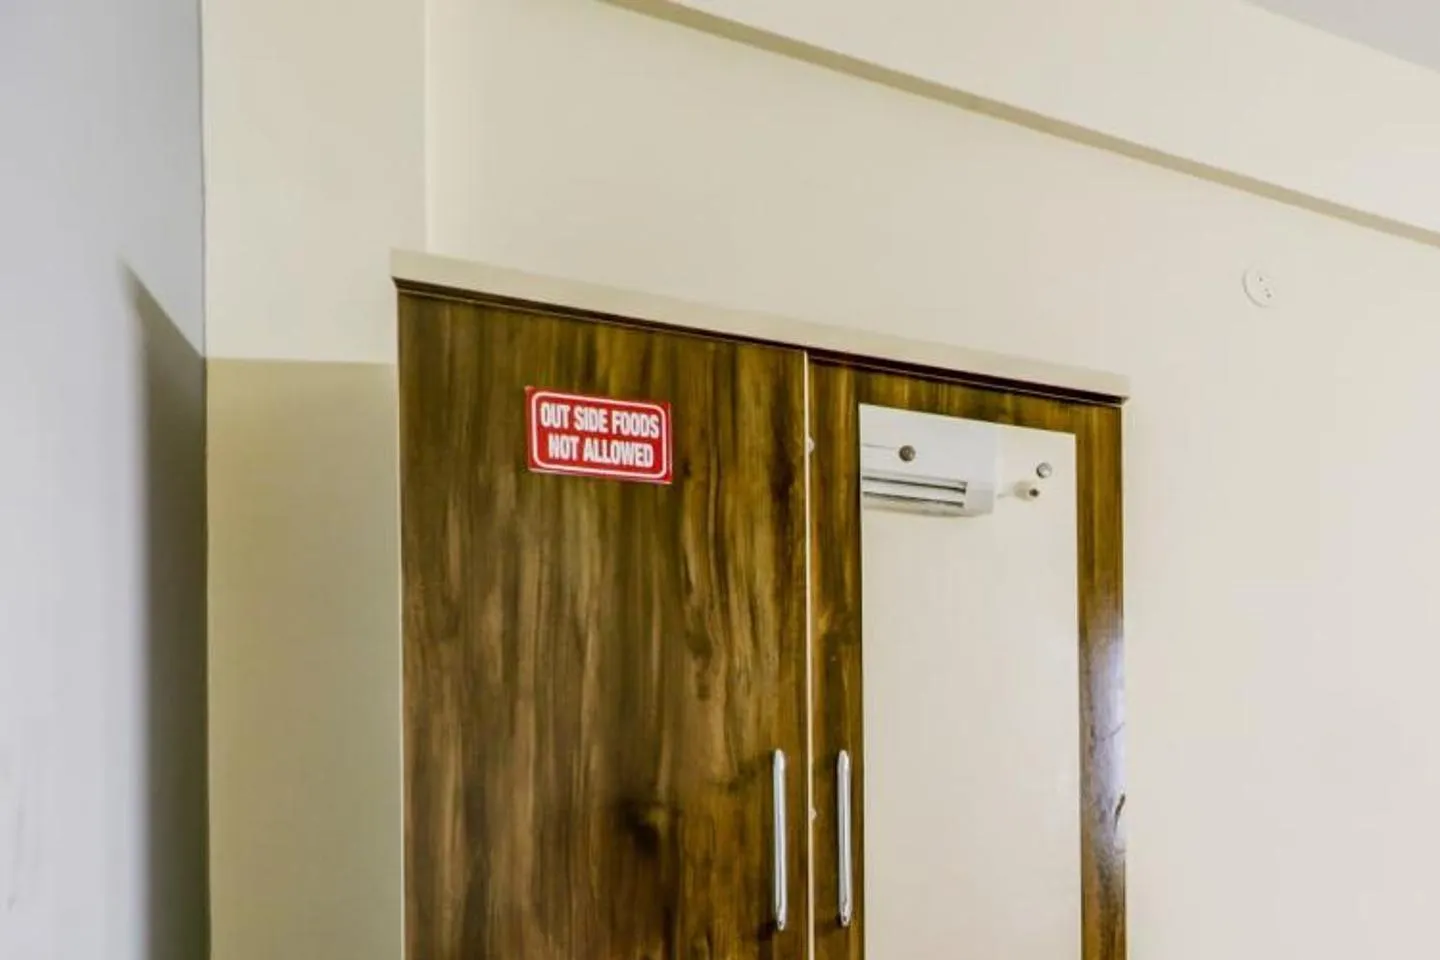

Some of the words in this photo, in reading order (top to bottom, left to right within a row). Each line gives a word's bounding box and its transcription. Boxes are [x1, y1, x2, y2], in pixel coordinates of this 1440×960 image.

[540, 401, 570, 429] OUT
[574, 405, 608, 433] SIDE
[611, 409, 660, 438] FOODS
[548, 433, 580, 461] NOT
[583, 437, 654, 468] ALLOWED
